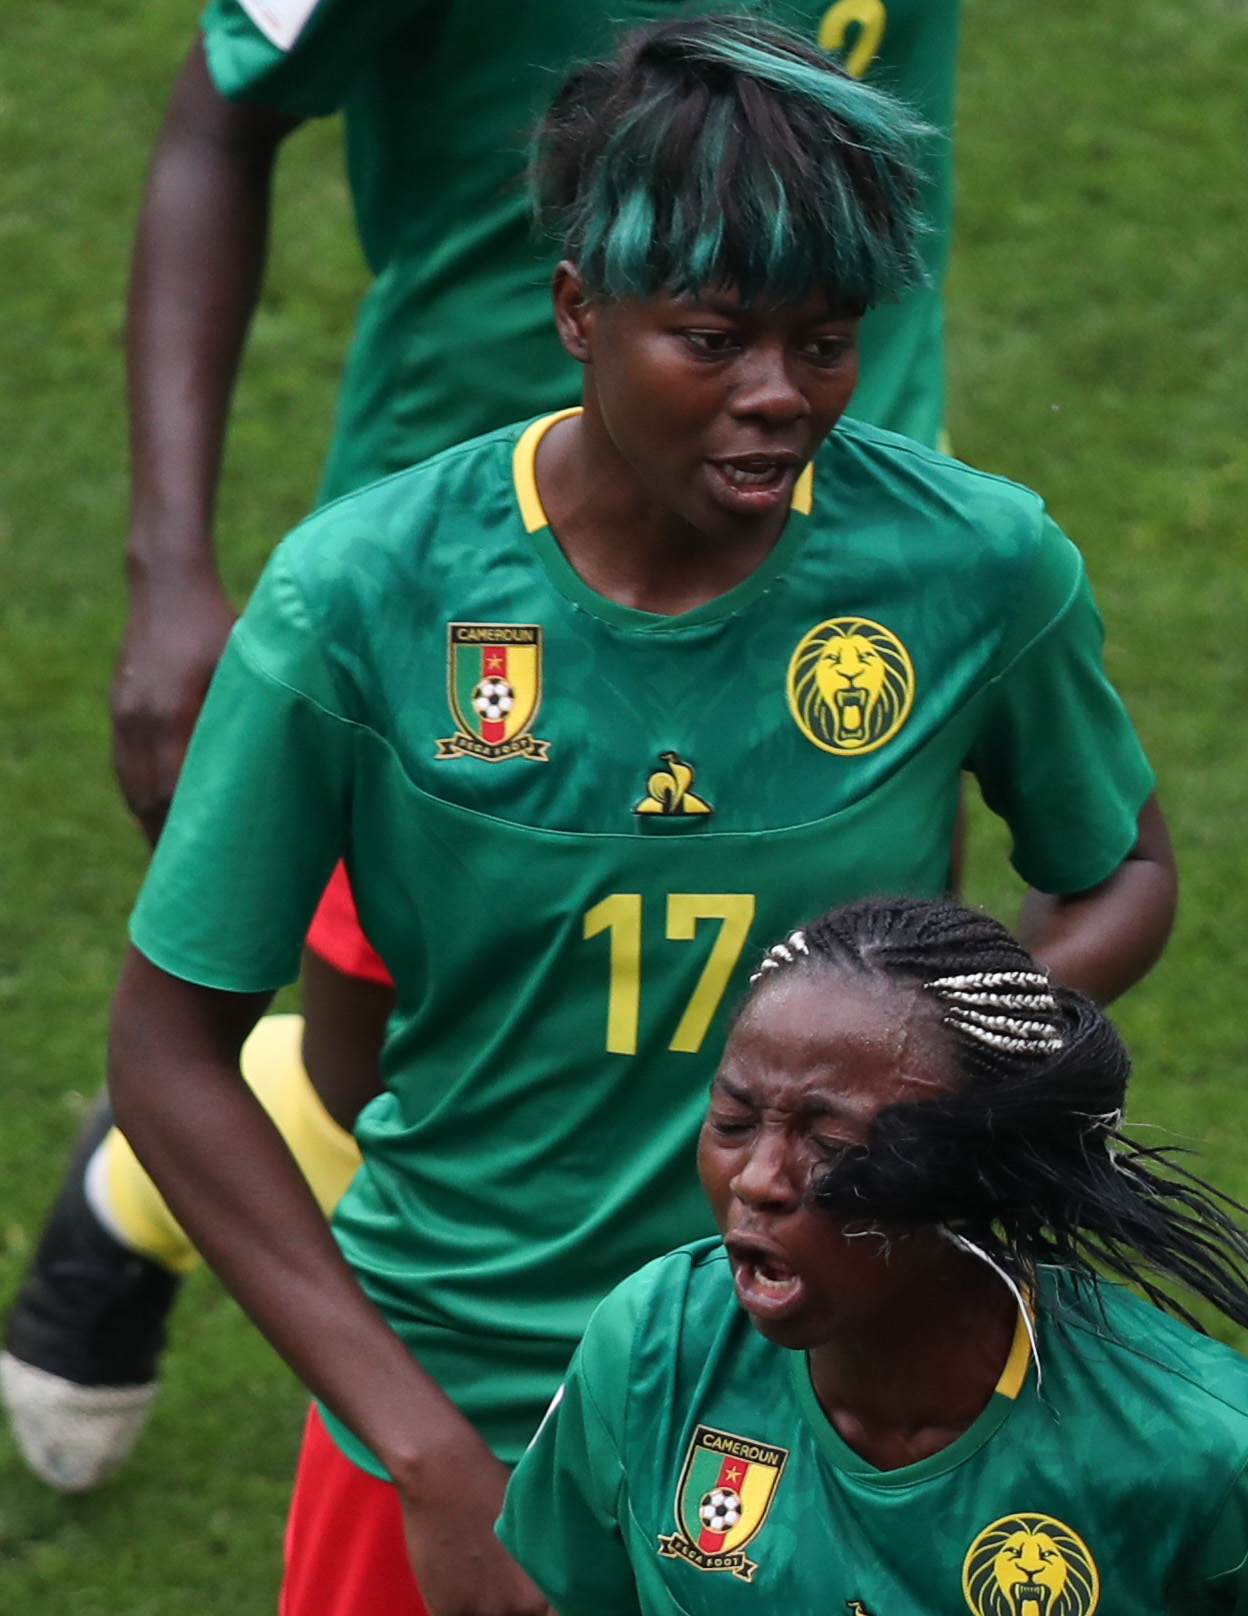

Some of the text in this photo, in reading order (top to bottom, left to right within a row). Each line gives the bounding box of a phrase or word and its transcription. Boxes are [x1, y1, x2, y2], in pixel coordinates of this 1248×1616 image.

[456, 628, 534, 642] CAMEROUN
[583, 893, 756, 1056] 17
[702, 1433, 780, 1465] CAMEROUN
